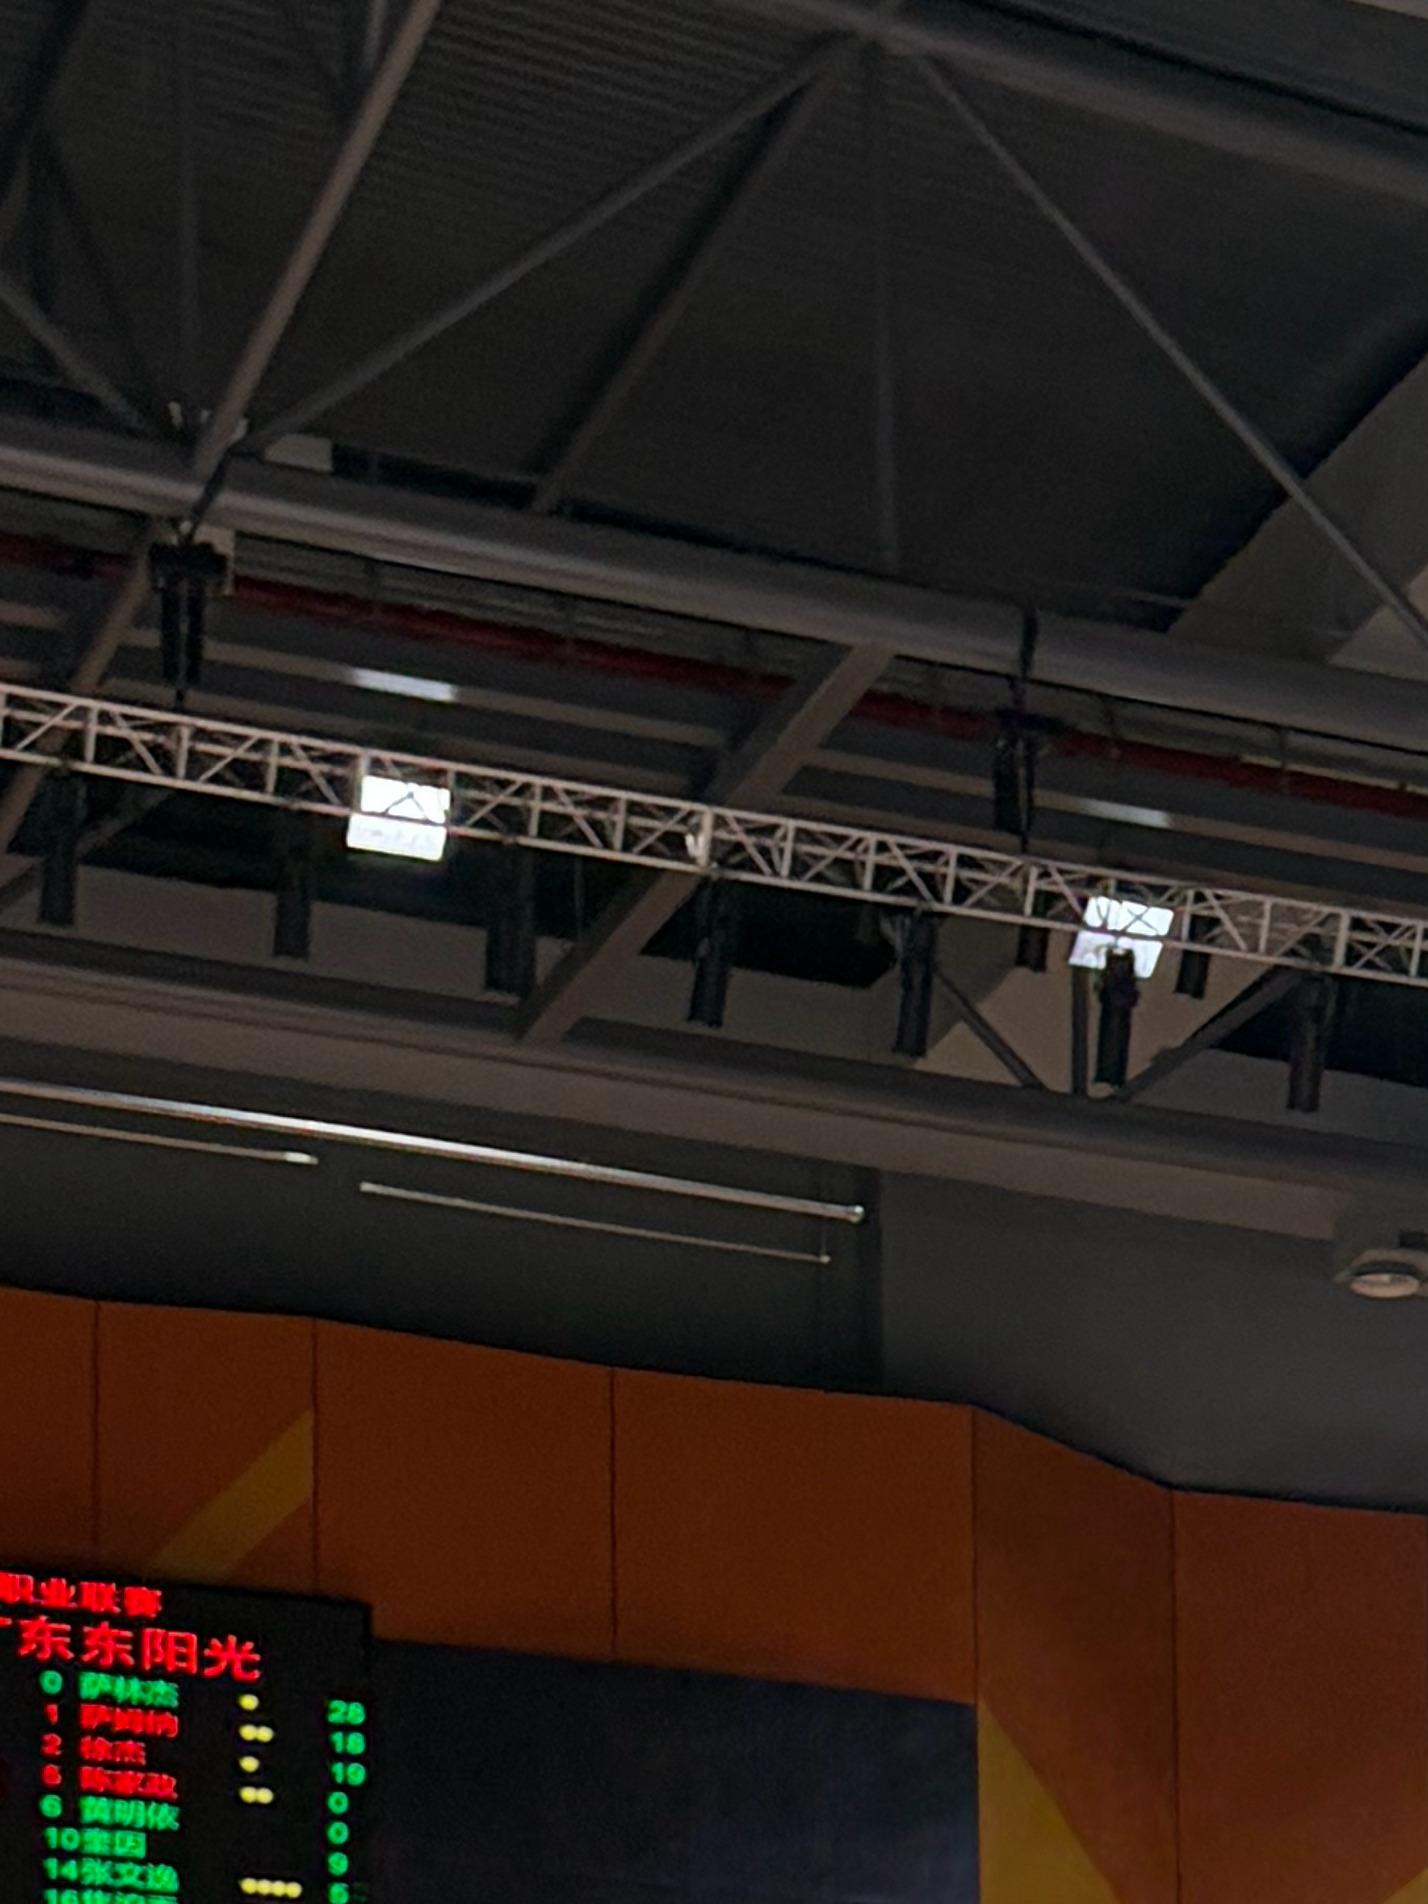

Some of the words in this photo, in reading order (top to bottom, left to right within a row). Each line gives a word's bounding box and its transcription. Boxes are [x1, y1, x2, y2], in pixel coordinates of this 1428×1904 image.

[0, 1616, 261, 1681] 东东阳光
[327, 1791, 349, 1815] 0
[43, 1827, 80, 1852] 10
[327, 1822, 349, 1845] 0
[43, 1857, 79, 1882] 14
